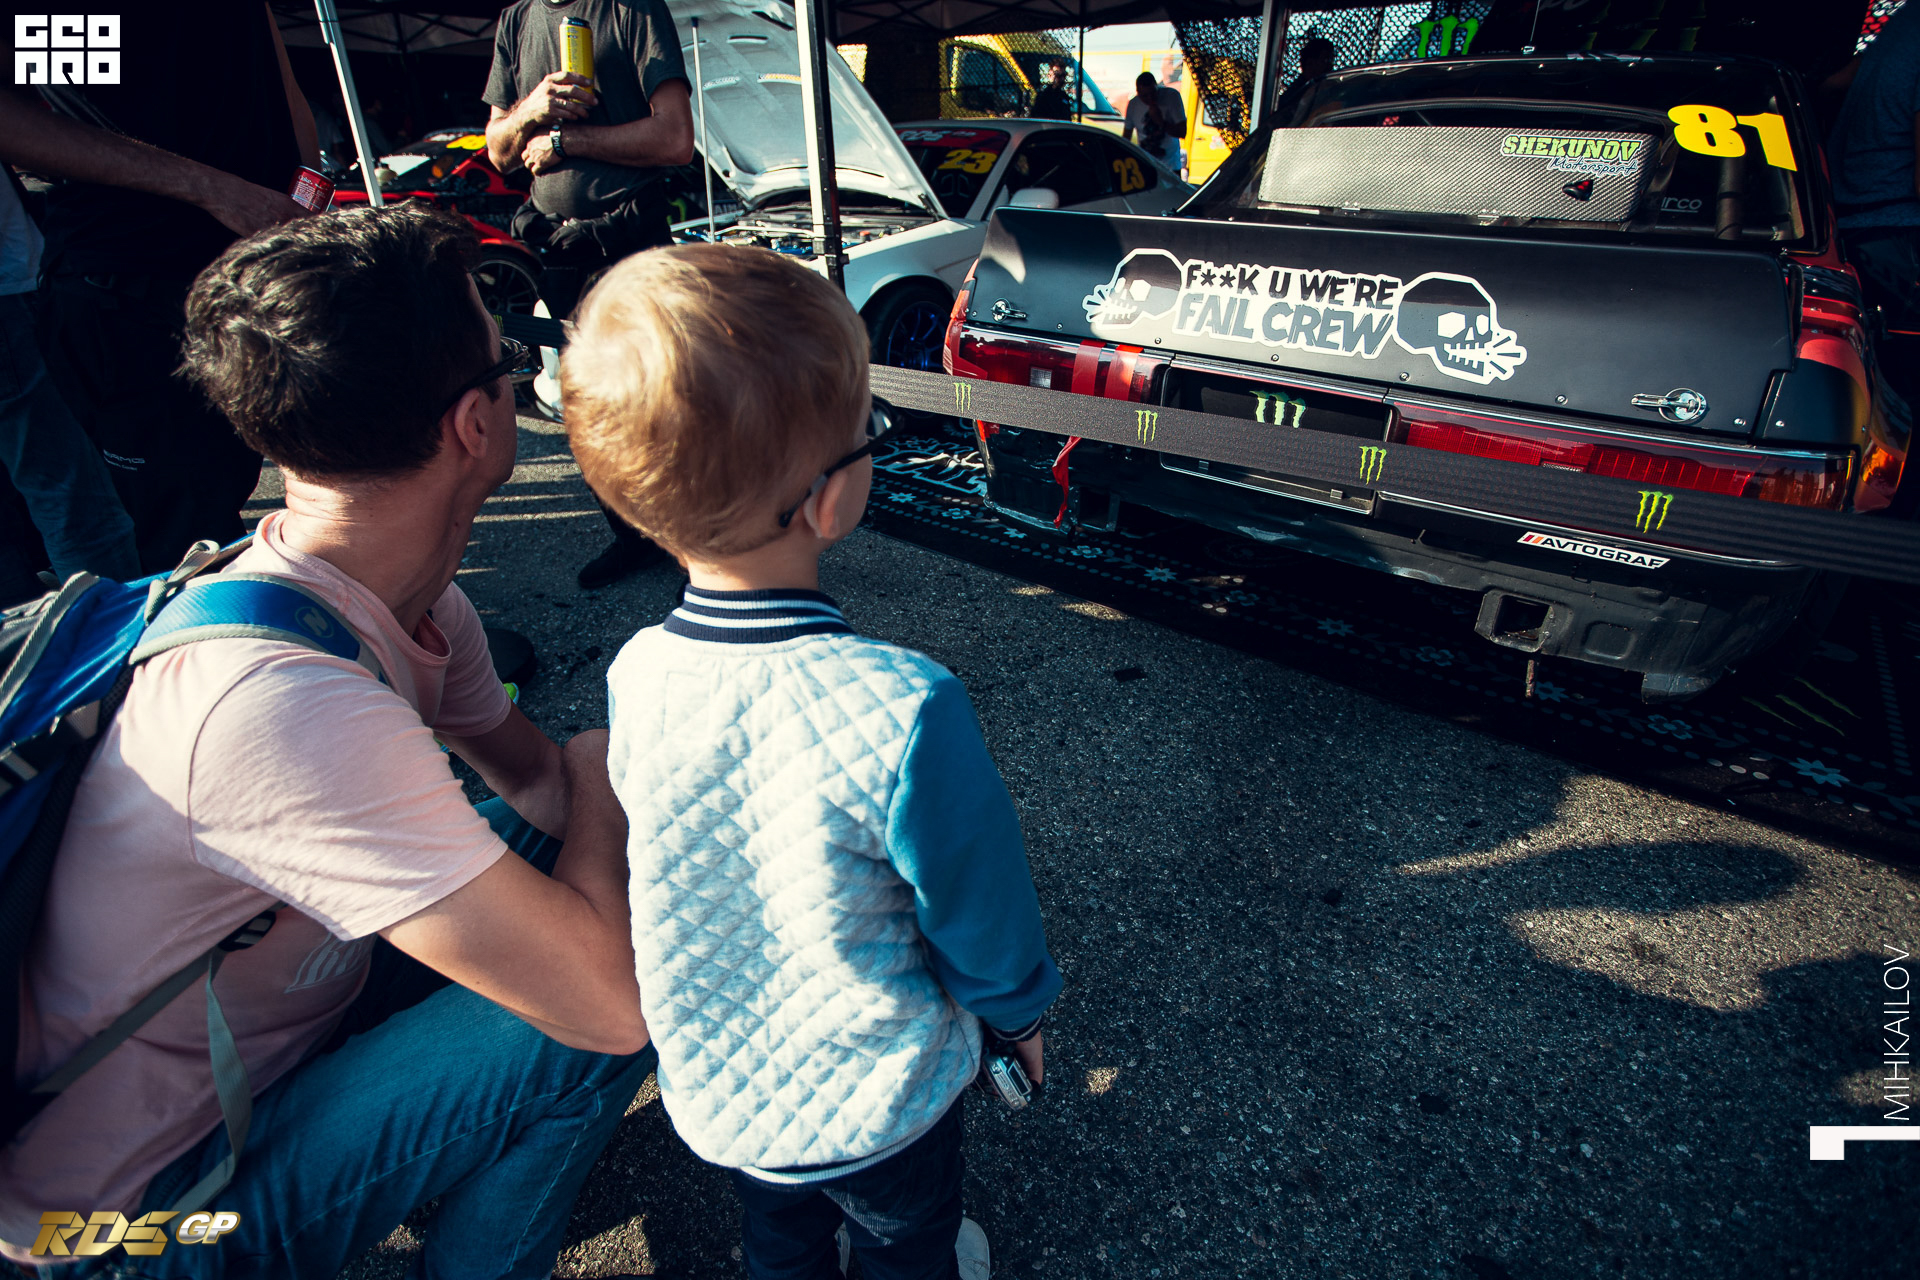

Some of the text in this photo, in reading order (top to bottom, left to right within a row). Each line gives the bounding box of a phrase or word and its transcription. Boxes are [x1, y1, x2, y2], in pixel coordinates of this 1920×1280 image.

[1502, 134, 1642, 163] SHEKUNOV
[1667, 104, 1798, 172] 81
[938, 148, 998, 174] 23
[1112, 157, 1146, 193] 23
[1548, 156, 1639, 177] Motorsport
[1661, 196, 1703, 211] rco
[1268, 270, 1292, 300] U
[1299, 273, 1399, 310] WE'RE
[1176, 292, 1395, 356] FAIL CREW
[1541, 537, 1665, 568] AVTOGRAF
